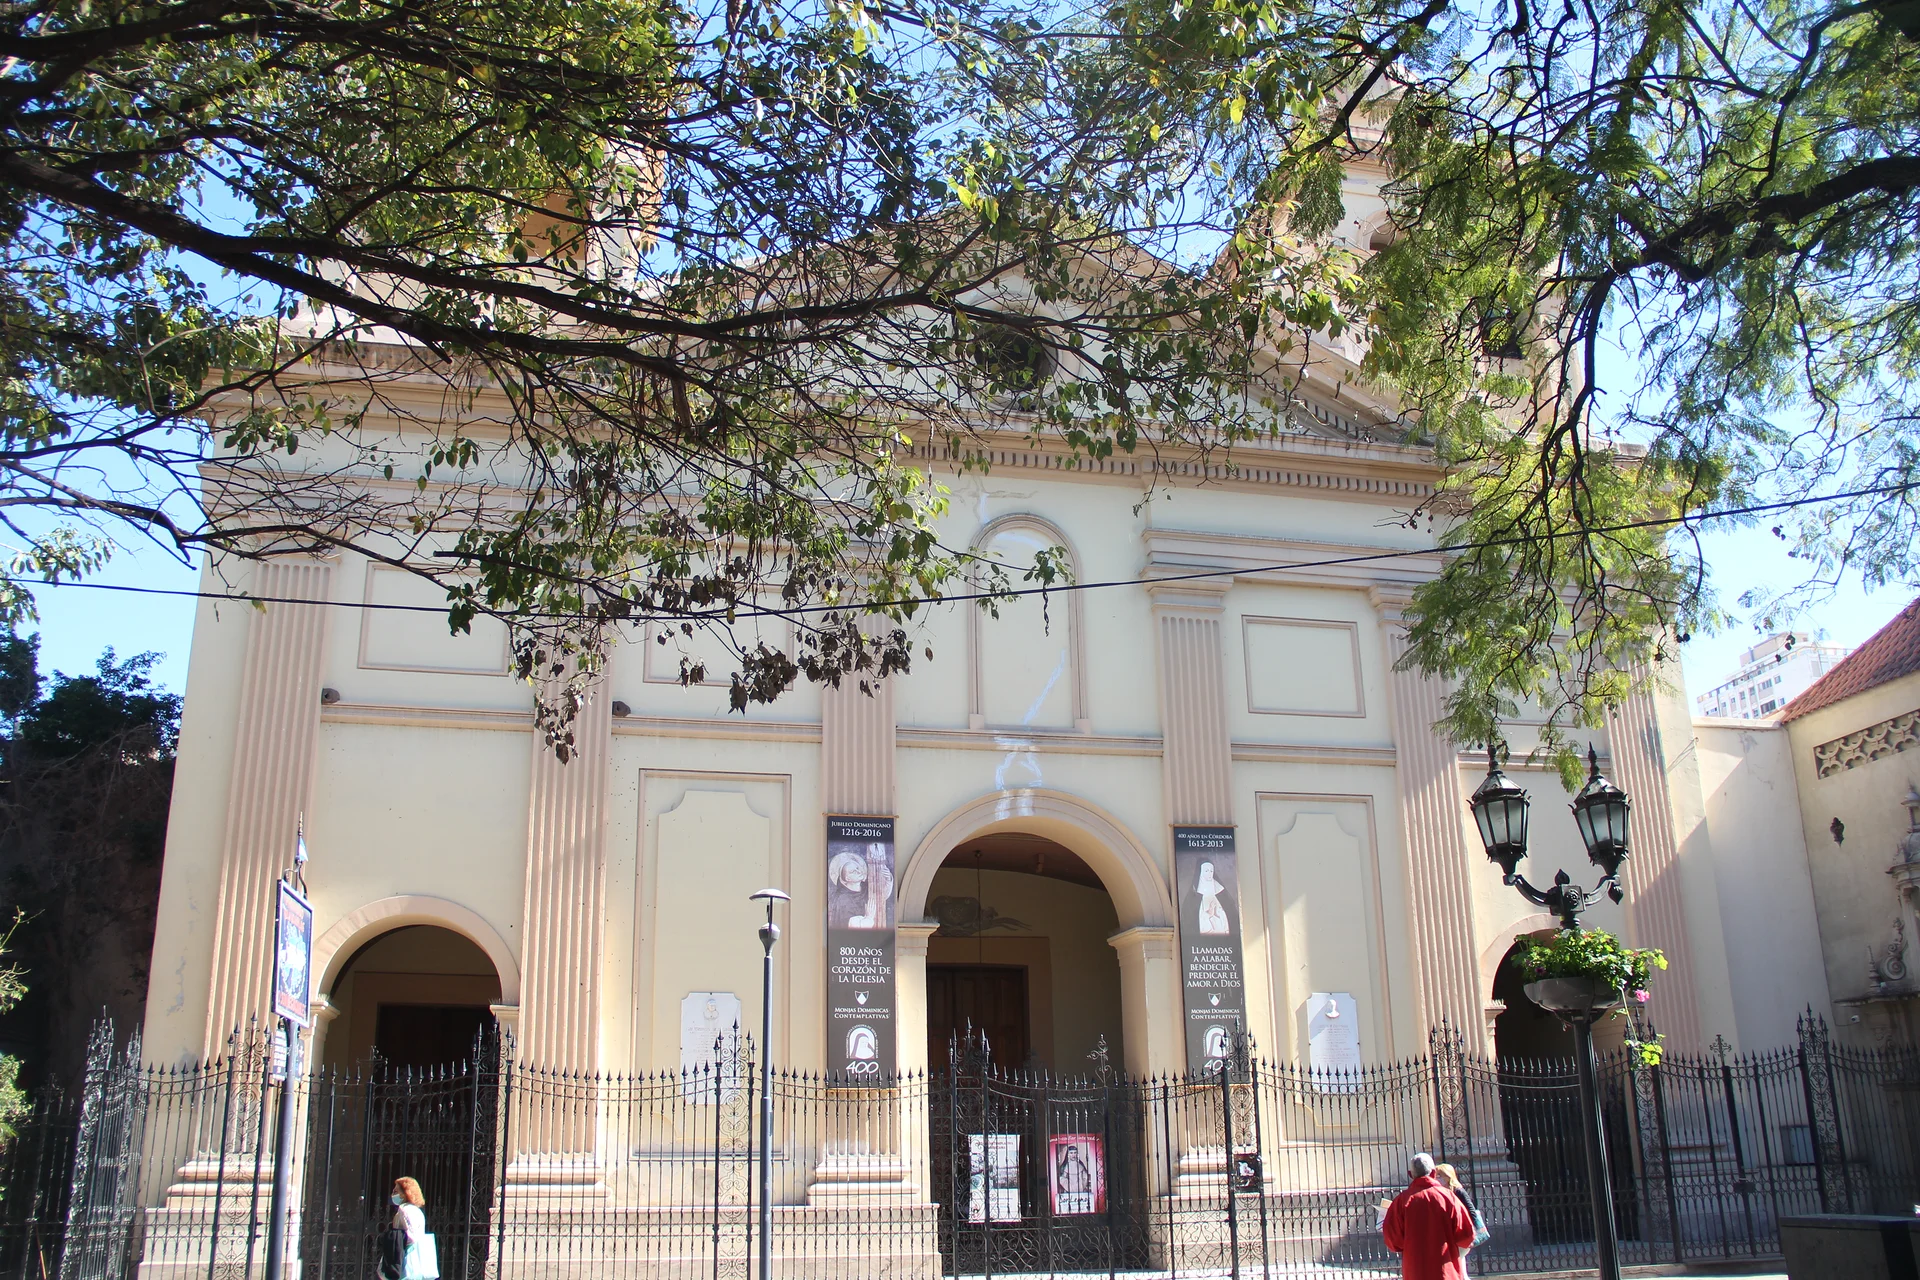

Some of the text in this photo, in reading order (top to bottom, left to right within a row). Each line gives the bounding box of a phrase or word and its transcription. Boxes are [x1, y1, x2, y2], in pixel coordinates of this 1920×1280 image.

[842, 828, 882, 837] 1216-2016
[1188, 840, 1224, 848] 1613-2013
[839, 947, 883, 957] 800 AÑOS
[1191, 946, 1233, 955] LLAMADAS
[841, 957, 870, 965] DESDE
[1201, 956, 1232, 964] ALABAR,
[831, 965, 892, 975] CORAZÓN DE
[838, 974, 886, 984] LA IGLESIA
[1186, 980, 1212, 988] AMOR
[1221, 980, 1241, 988] DIOS
[846, 1061, 879, 1074] 400
